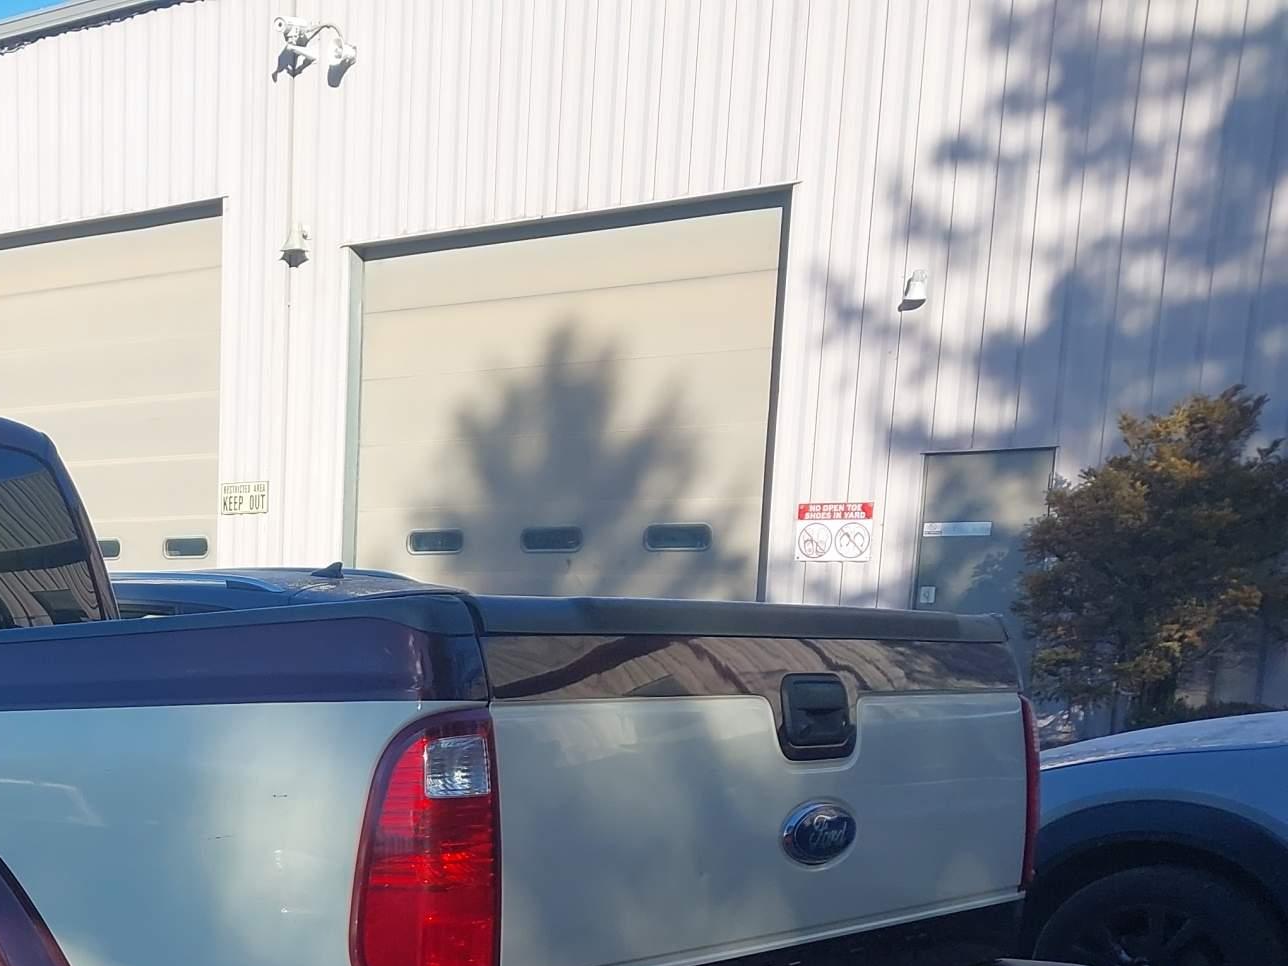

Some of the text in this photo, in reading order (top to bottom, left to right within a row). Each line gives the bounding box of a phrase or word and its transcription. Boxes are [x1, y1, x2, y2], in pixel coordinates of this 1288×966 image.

[223, 483, 266, 494] RESTRICTED AREA
[223, 494, 266, 511] KEEP OUT
[809, 503, 863, 512] NO OPEN TOE
[805, 511, 866, 520] SHOES IN YARD
[809, 813, 848, 846] Ford
